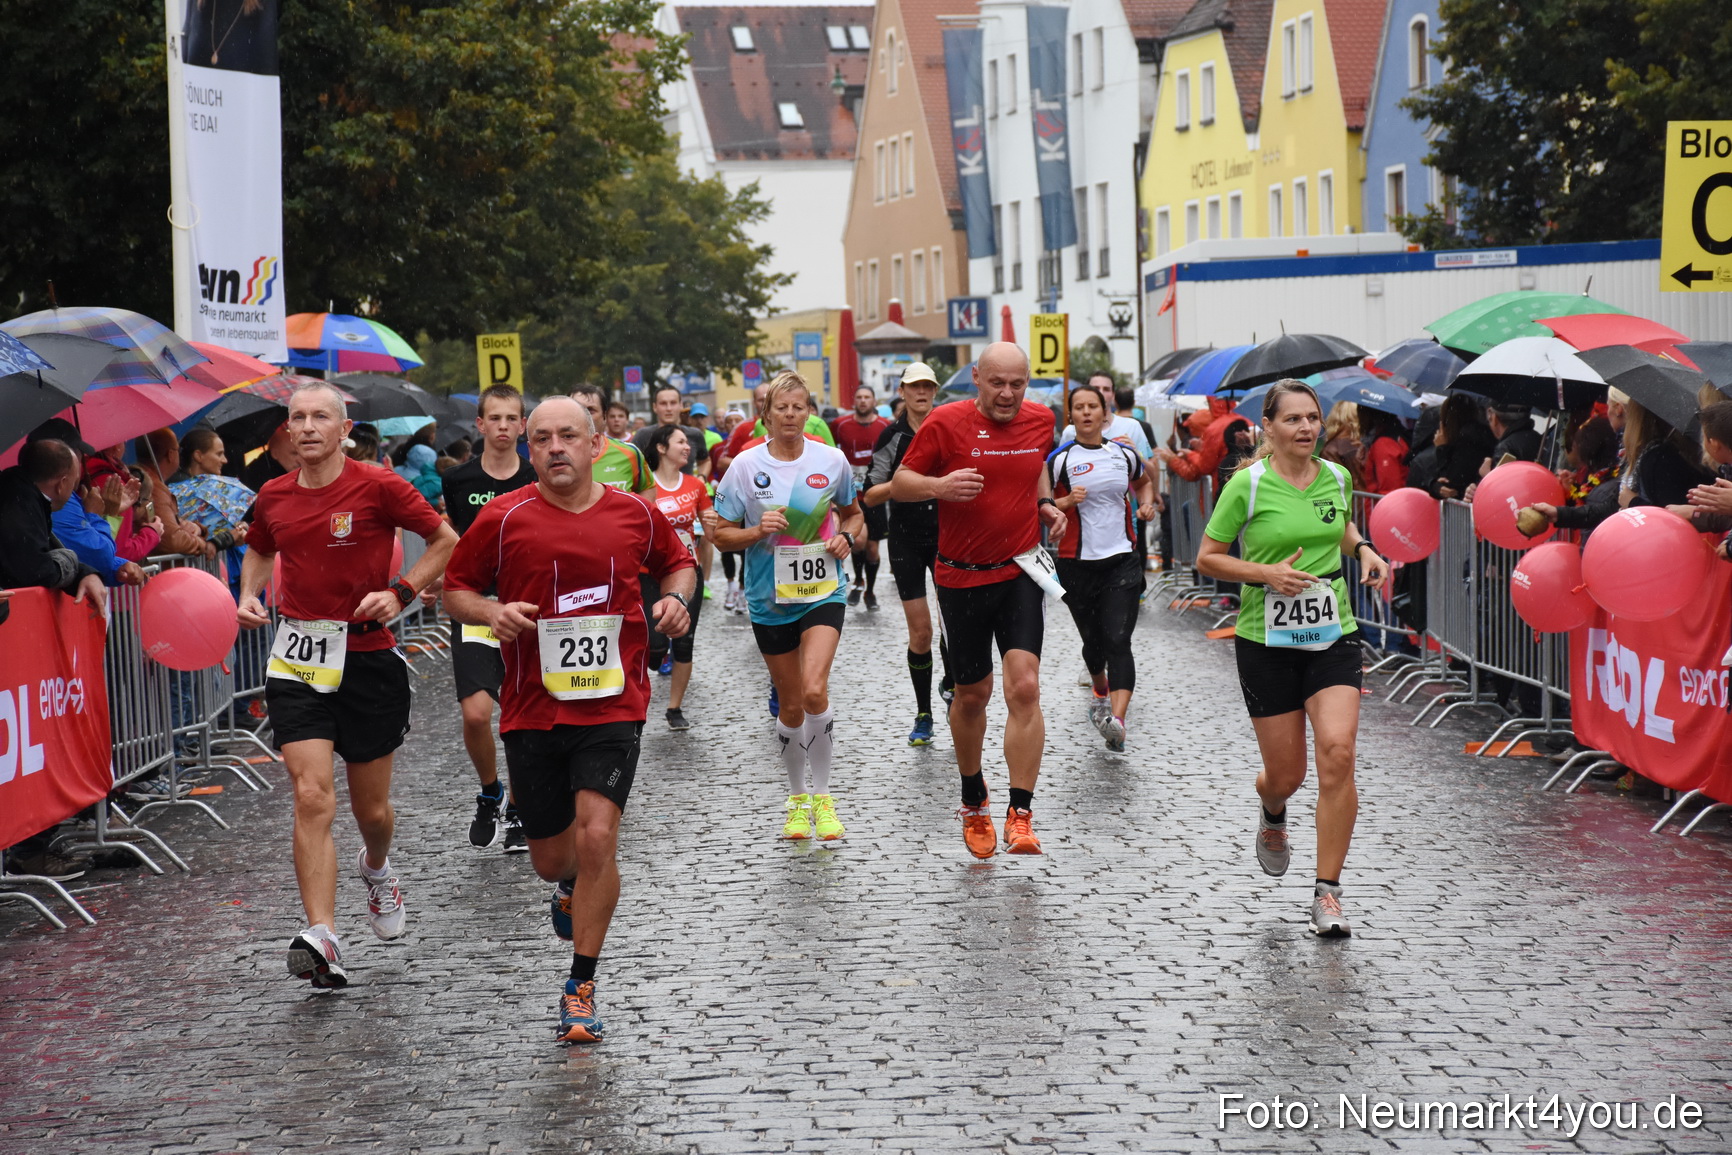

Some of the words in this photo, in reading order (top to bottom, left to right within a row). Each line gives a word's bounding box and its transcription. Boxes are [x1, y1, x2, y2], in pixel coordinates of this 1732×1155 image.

[200, 114, 218, 133] DA!
[1190, 160, 1218, 190] HOTEL
[218, 308, 267, 323] neumarkt
[1034, 315, 1065, 328] Block
[481, 336, 515, 349] Block
[1040, 333, 1059, 363] D
[489, 354, 511, 384] D
[788, 557, 826, 581] 198
[572, 592, 595, 604] DEHN
[797, 585, 818, 595] Heidi
[1273, 595, 1334, 626] 2454
[578, 617, 616, 630] BOCK
[1291, 632, 1320, 643] Heike
[284, 632, 328, 664] 201
[559, 636, 608, 668] 233
[570, 675, 600, 688] Mario
[607, 767, 620, 786] GORE
